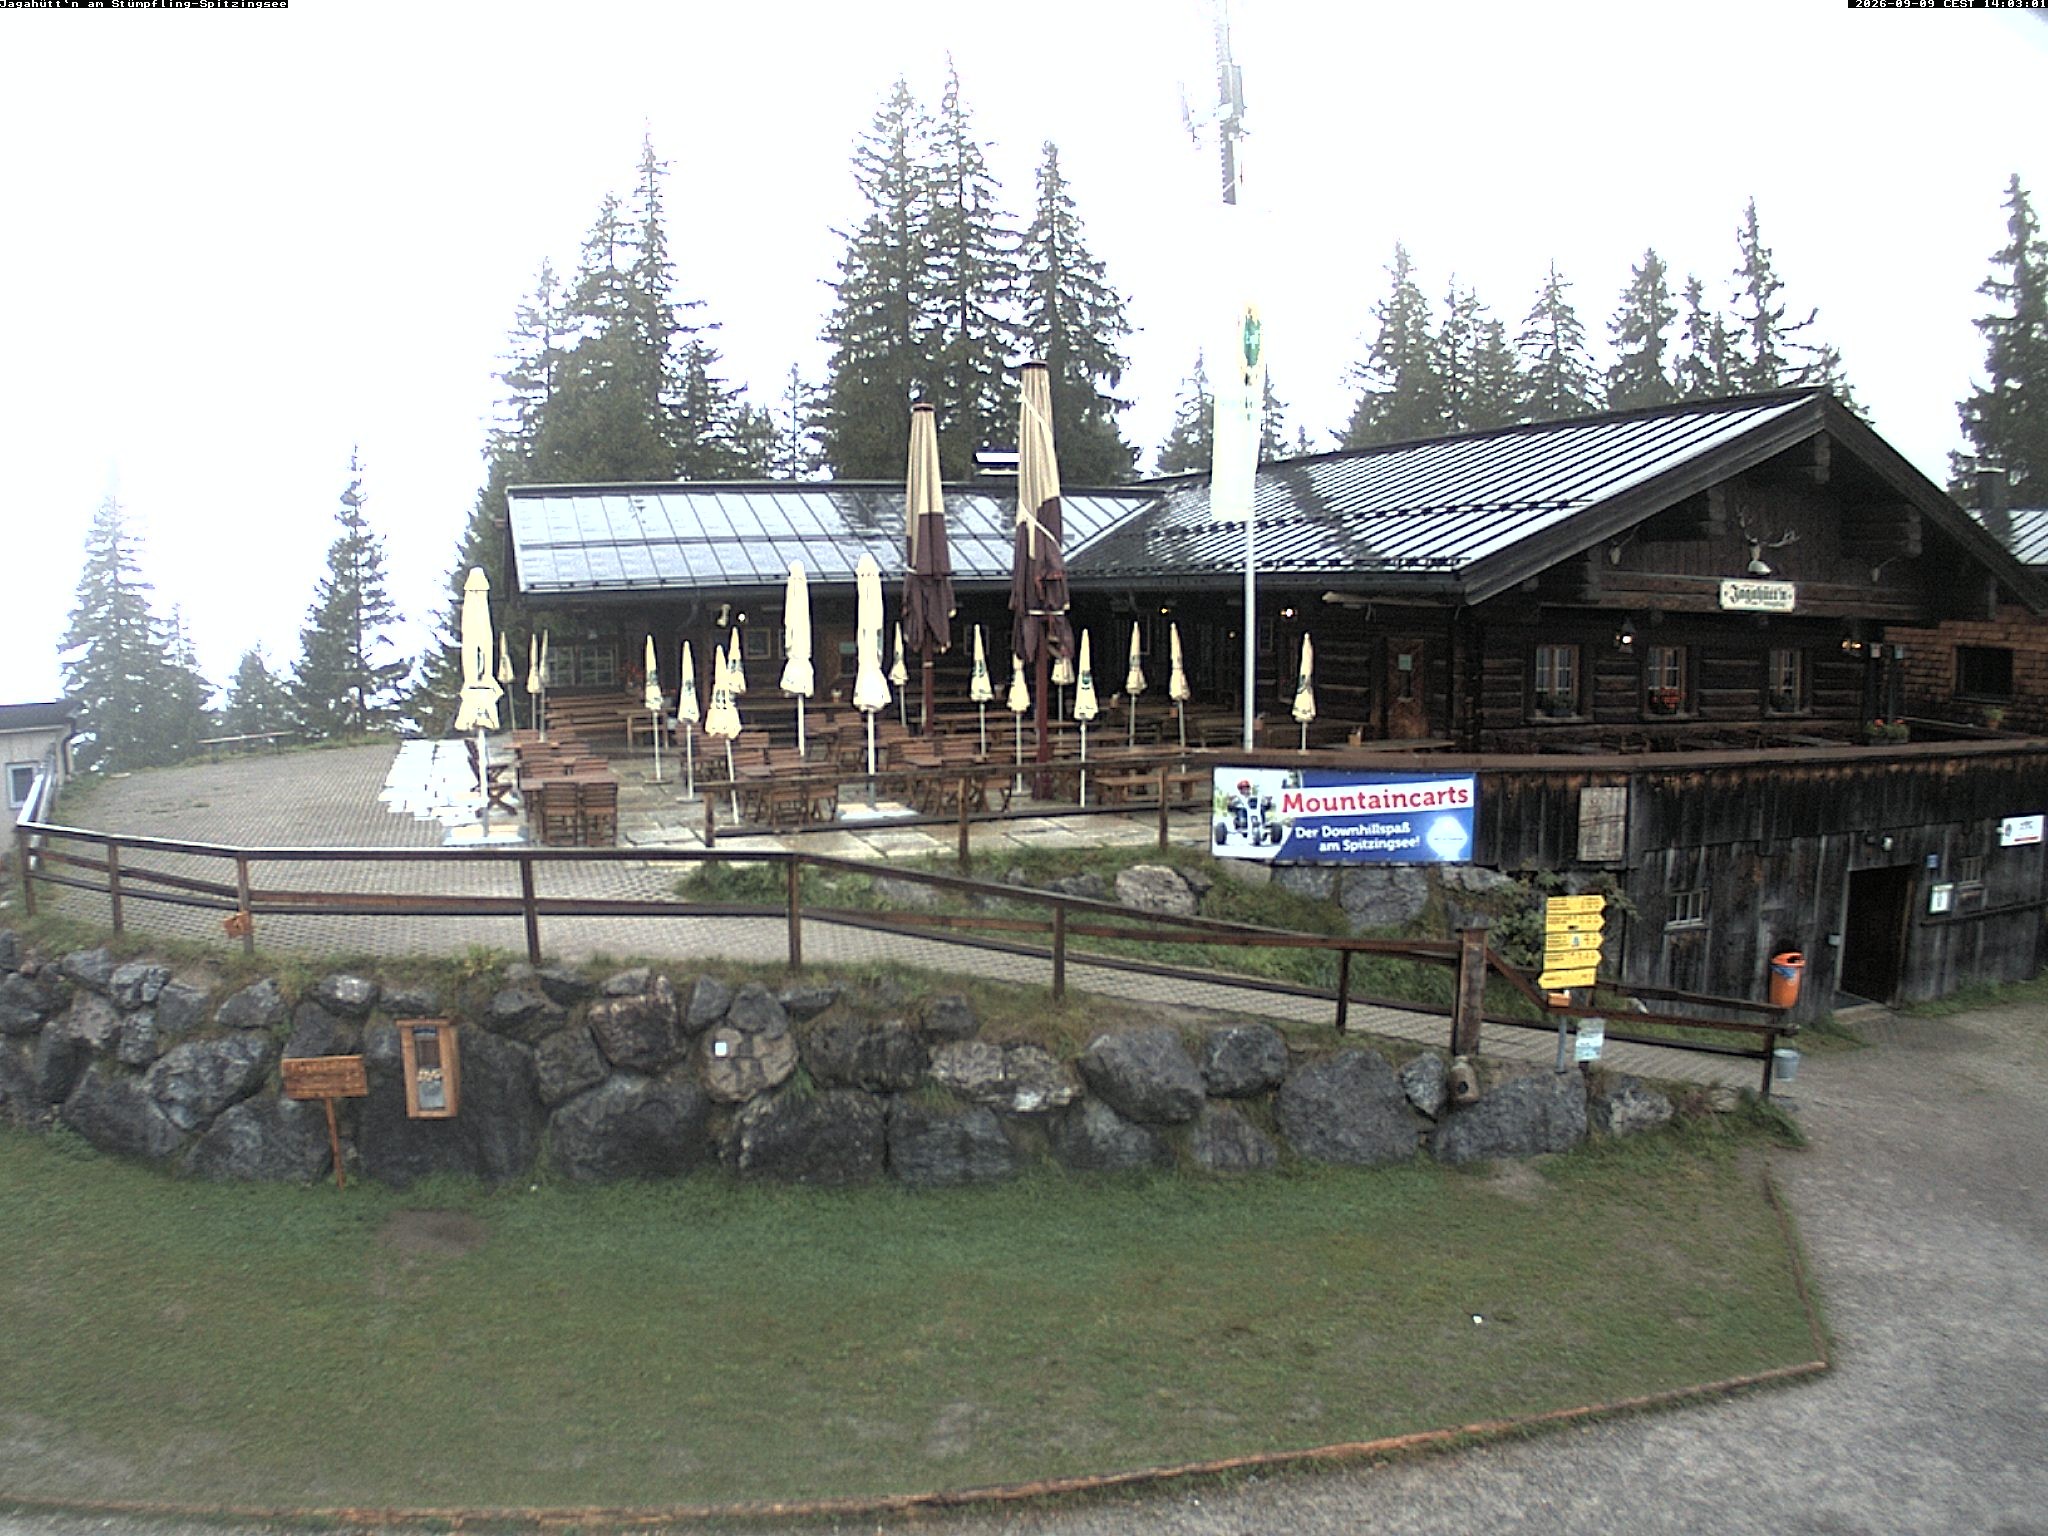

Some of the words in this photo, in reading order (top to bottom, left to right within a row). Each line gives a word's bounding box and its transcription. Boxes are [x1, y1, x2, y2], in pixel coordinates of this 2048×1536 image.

[1282, 785, 1469, 813] Mountaincarts
[1295, 826, 1319, 839] Der
[1321, 822, 1411, 840] Downhillspaß
[1319, 840, 1340, 852] am
[1342, 836, 1421, 854] Spitzingsee!
